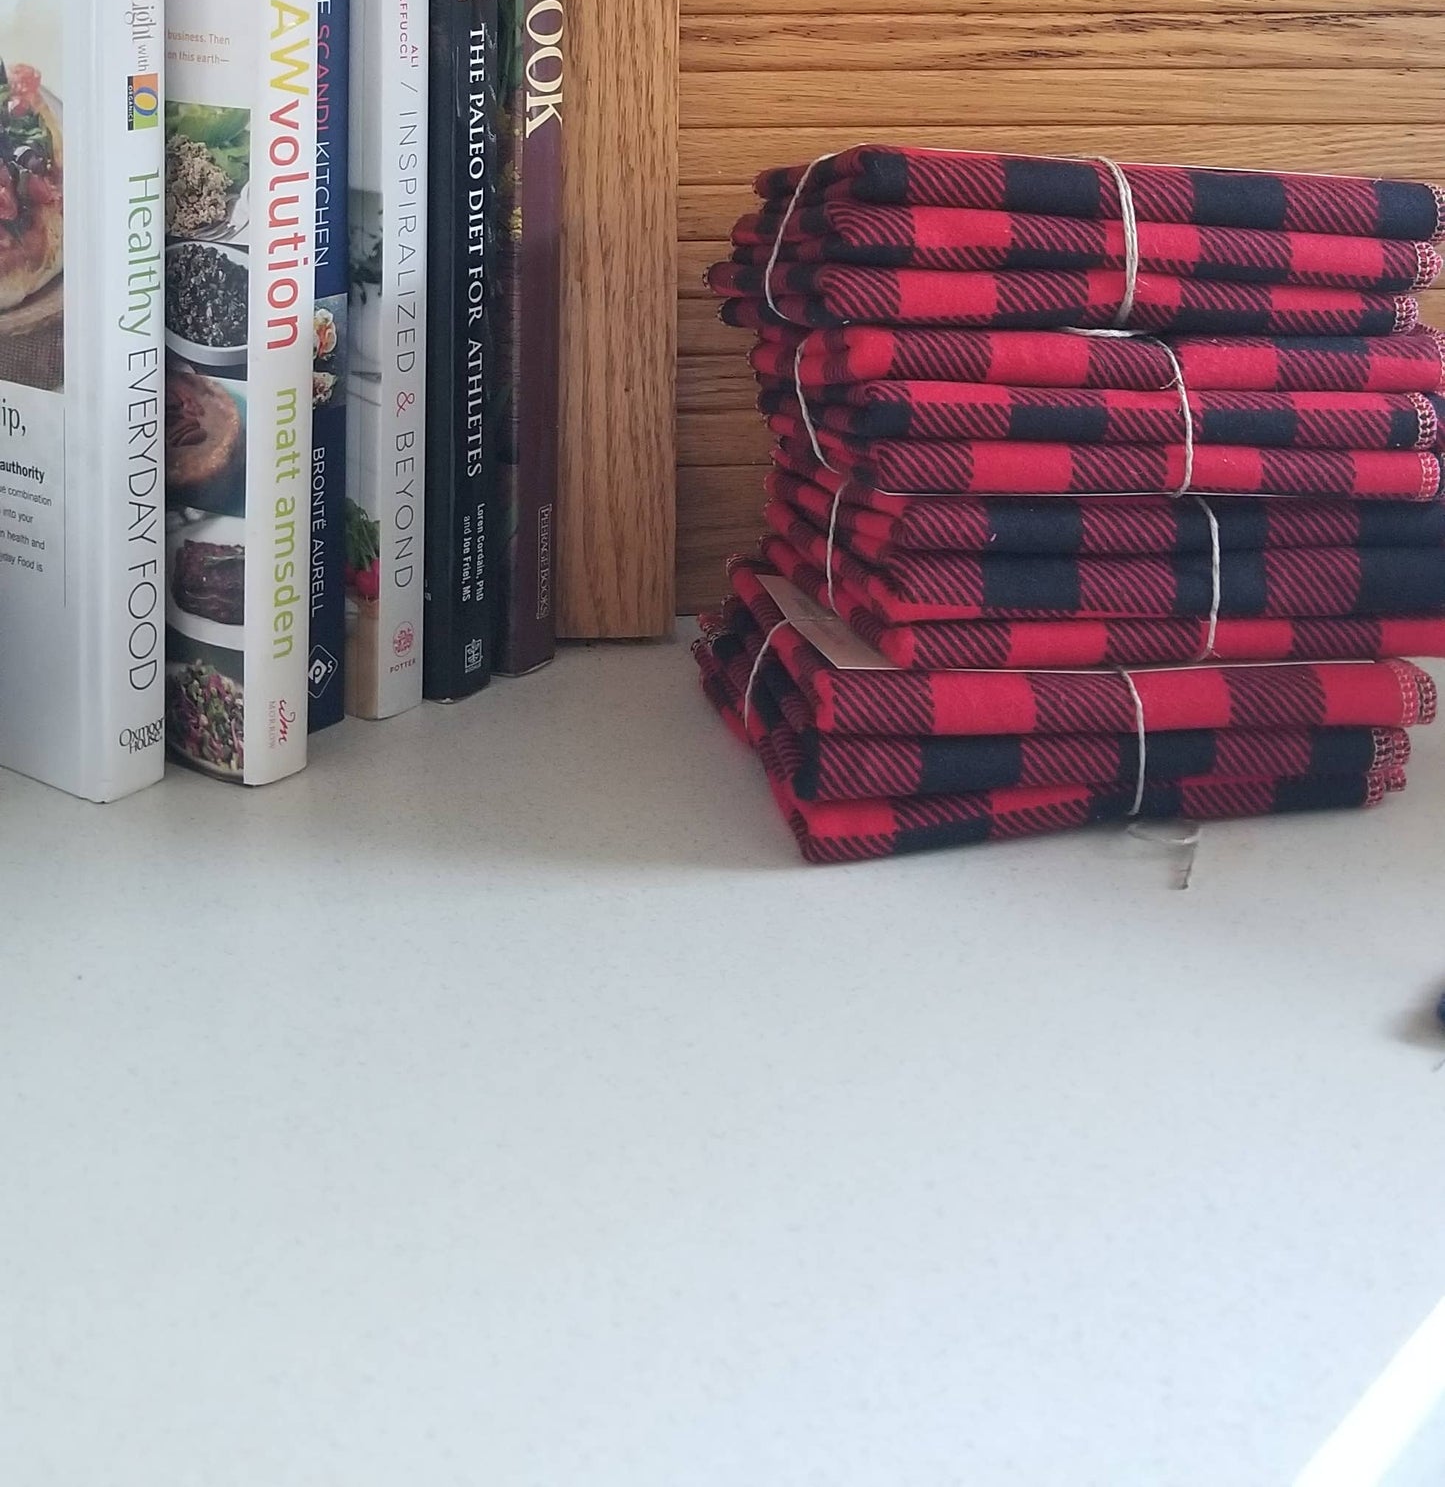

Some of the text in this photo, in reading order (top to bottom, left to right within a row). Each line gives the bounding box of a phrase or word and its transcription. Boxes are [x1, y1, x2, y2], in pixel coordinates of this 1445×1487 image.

[167, 29, 230, 45] business. Then
[137, 44, 150, 72] with
[179, 51, 195, 62] this
[410, 45, 419, 68] ALI
[317, 24, 331, 131] SCANDI
[314, 141, 331, 267] KITCHEN
[397, 111, 418, 373] INSPIRALIZED
[466, 23, 485, 478] THE PALEO DIET FOR ATHLETES
[396, 390, 416, 417] &
[118, 167, 161, 691] Healthy EVERYDAY FOOD
[0, 460, 46, 484] authority
[8, 487, 52, 507] combination
[394, 431, 415, 588] BEYOND
[18, 512, 34, 524] your
[272, 387, 300, 659] matt amsden
[463, 515, 472, 535] and
[7, 530, 30, 546] health
[31, 537, 46, 551] and
[463, 537, 472, 554] Joe
[475, 502, 486, 602] Loren Cordain, PhD
[17, 555, 35, 570] Food
[311, 540, 326, 618] AURELL
[540, 568, 550, 615] BOOKS
[461, 585, 471, 602] MS
